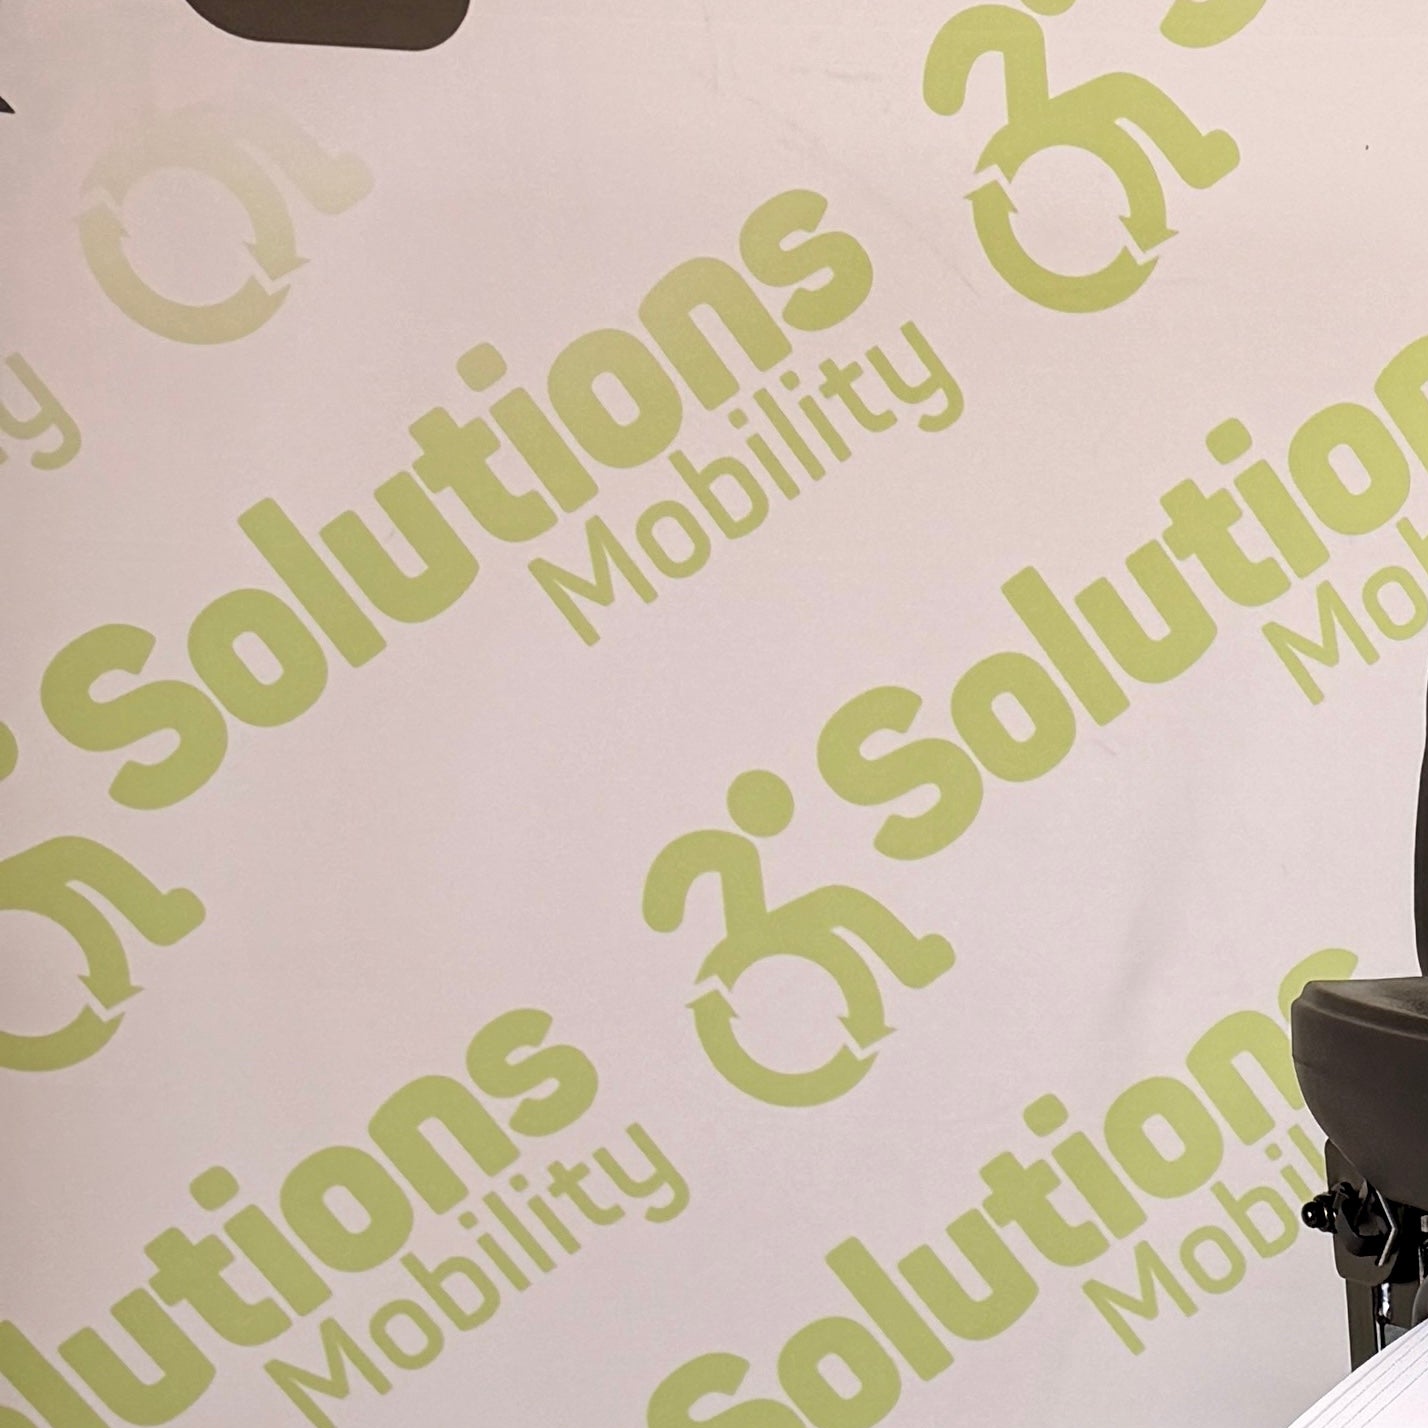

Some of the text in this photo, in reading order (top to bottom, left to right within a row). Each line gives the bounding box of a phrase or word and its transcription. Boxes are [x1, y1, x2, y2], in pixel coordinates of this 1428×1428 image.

[42, 191, 872, 808] Solutions
[530, 324, 962, 643] Mobility
[1084, 1124, 1324, 1352] Mobil
